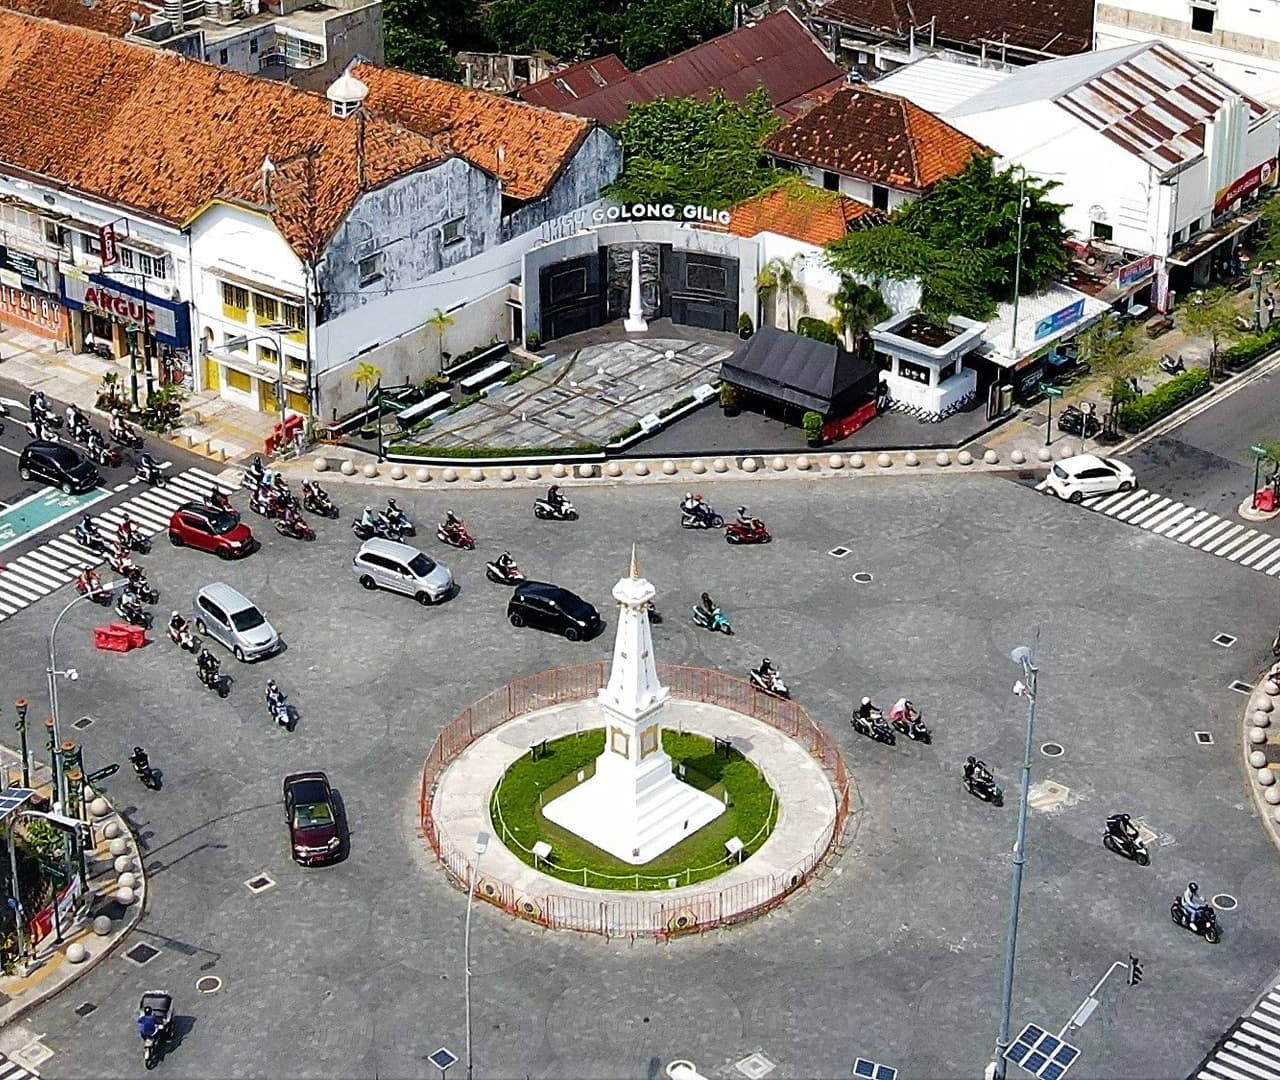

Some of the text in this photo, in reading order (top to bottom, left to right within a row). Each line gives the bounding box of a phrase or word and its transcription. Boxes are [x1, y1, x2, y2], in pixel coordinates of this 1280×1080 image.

[592, 203, 676, 221] GOLONG
[683, 204, 731, 225] GILIG
[84, 287, 156, 327] ARGUS
